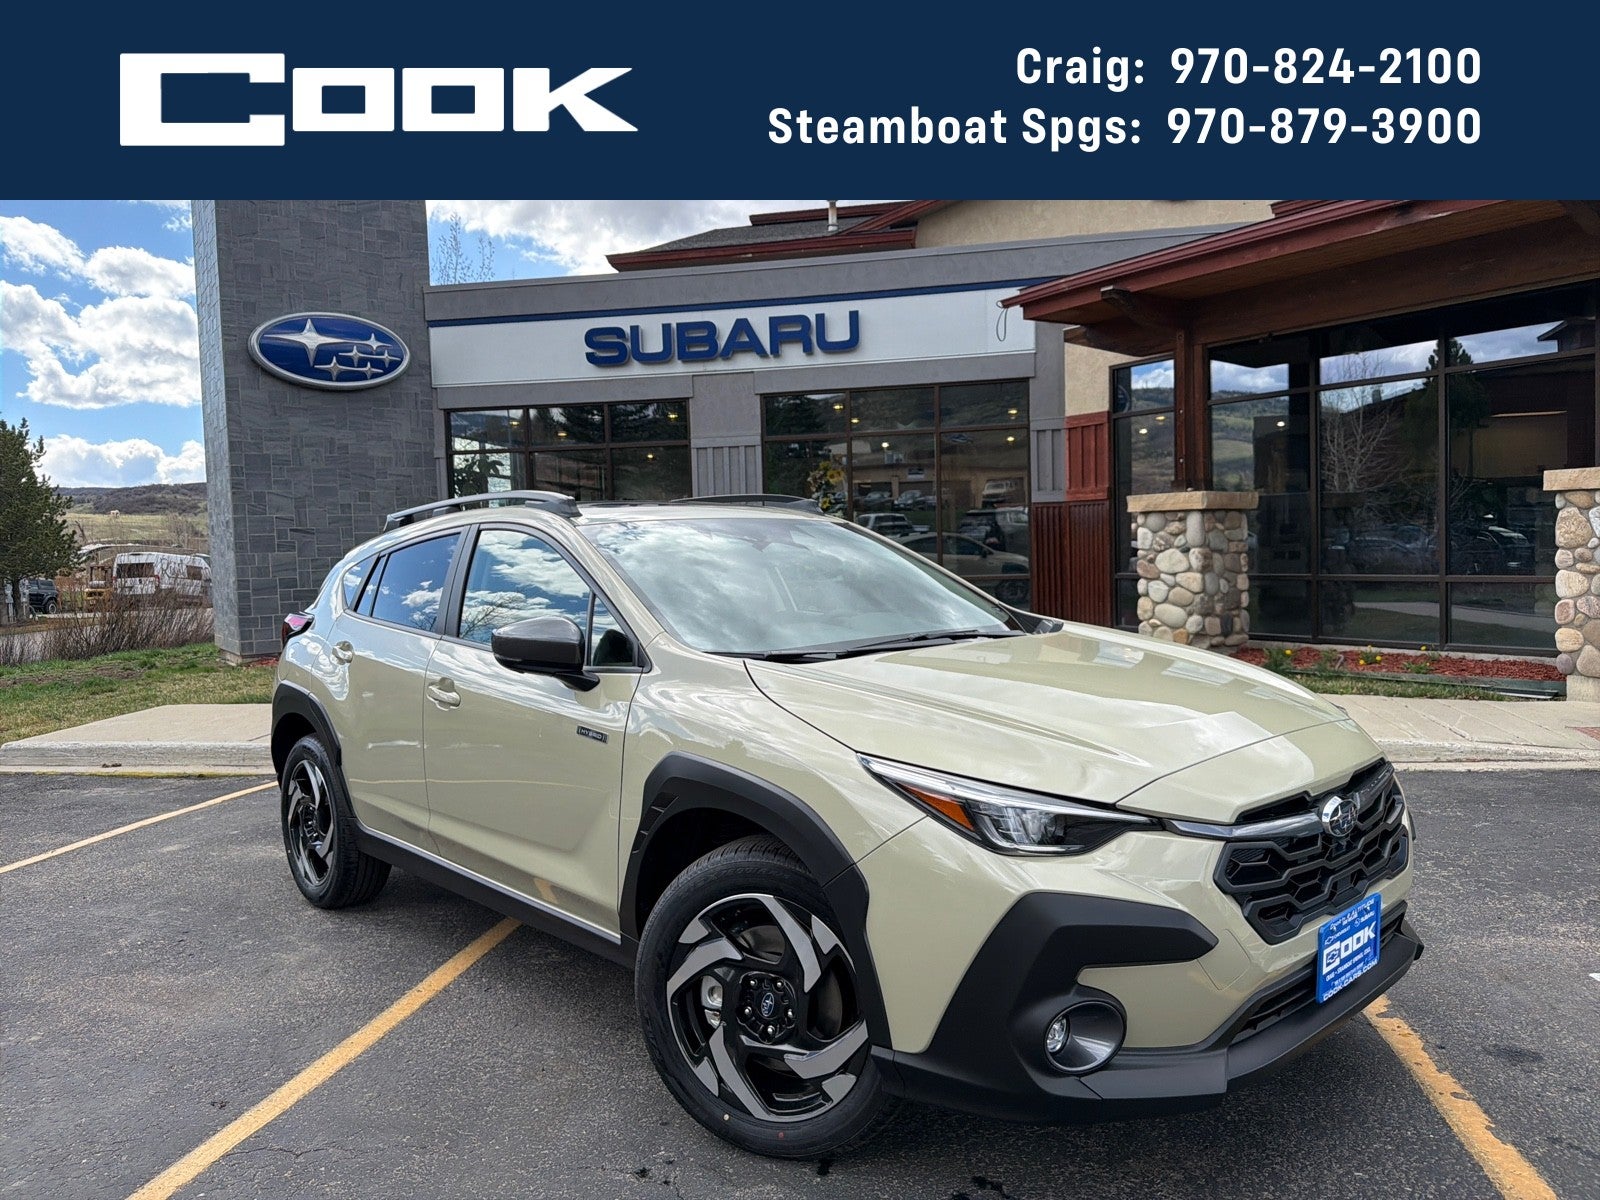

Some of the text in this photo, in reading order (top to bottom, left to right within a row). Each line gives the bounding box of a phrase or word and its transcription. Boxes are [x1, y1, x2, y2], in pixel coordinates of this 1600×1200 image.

[584, 310, 861, 367] SUBARU
[580, 728, 602, 740] HYBRID
[1323, 921, 1377, 975] COOK
